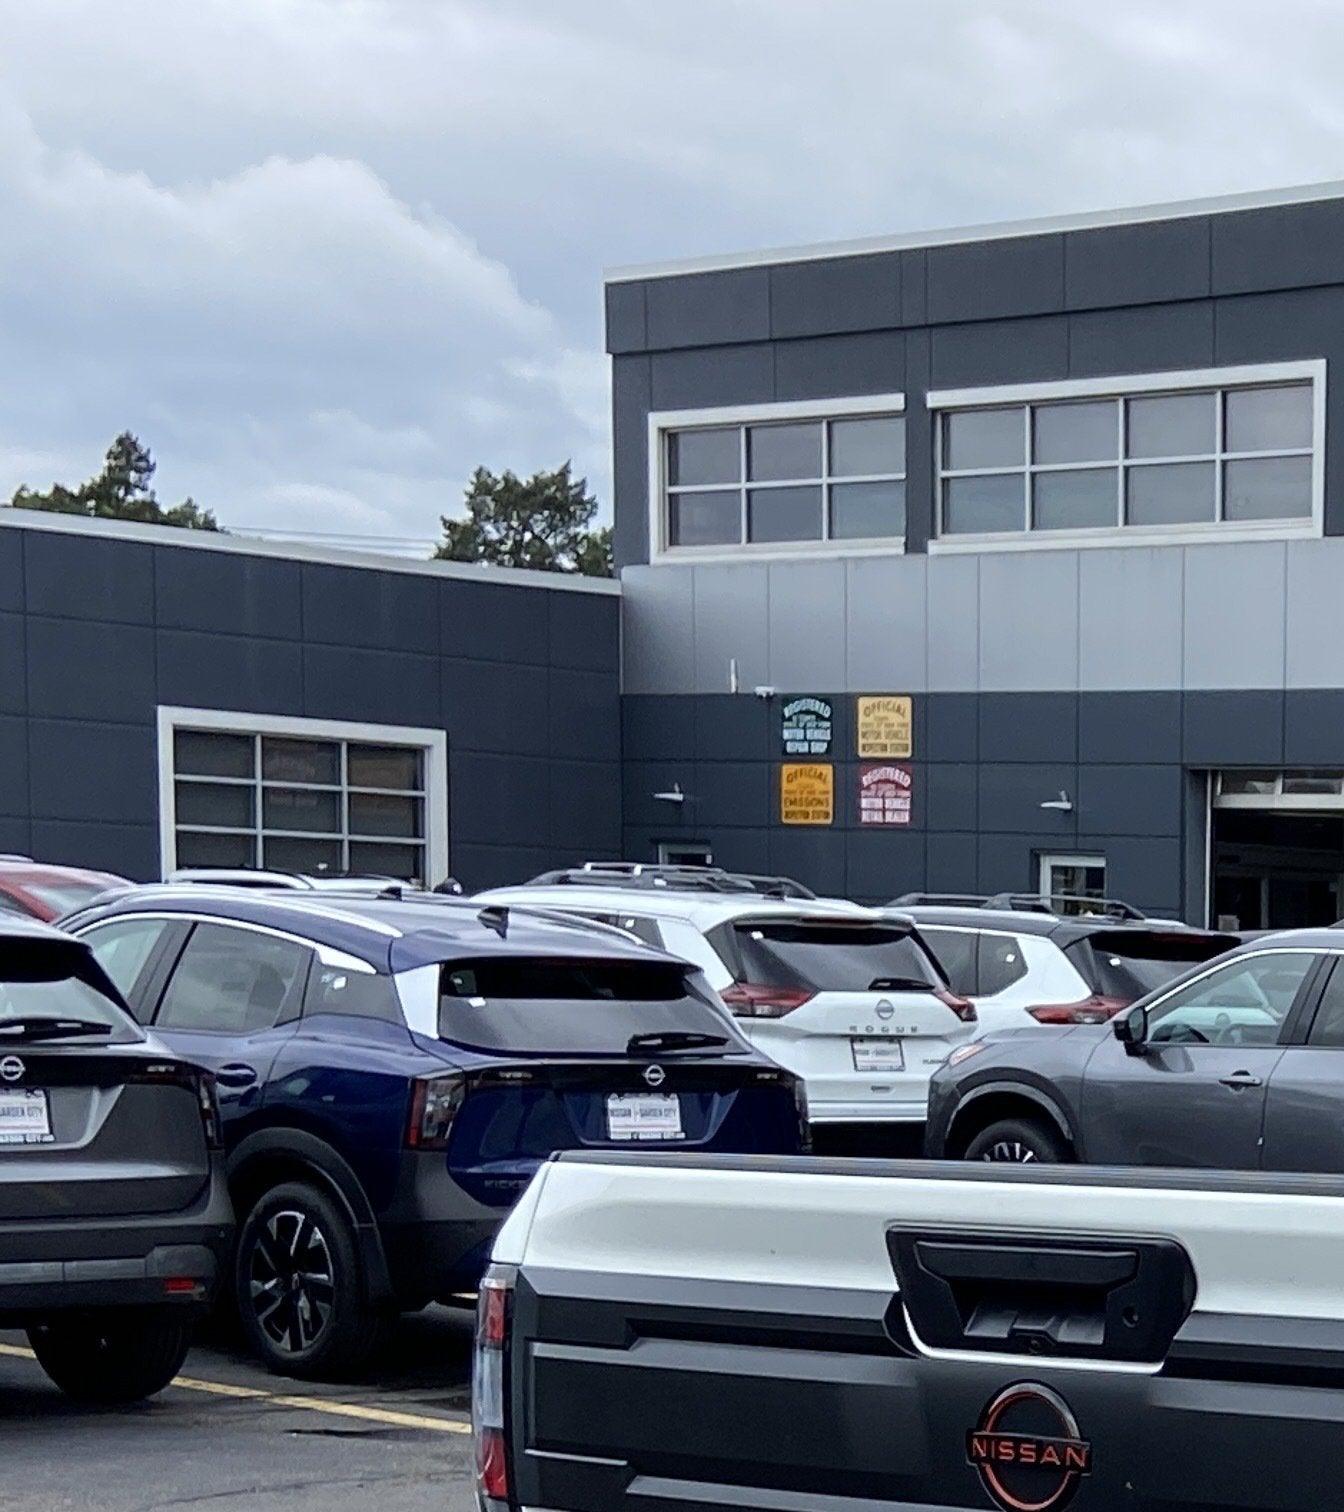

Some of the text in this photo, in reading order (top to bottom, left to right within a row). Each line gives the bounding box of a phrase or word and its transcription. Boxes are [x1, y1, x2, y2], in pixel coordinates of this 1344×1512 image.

[863, 700, 907, 718] OFFICIAL
[786, 767, 828, 784] OFFICIAL
[971, 1437, 1090, 1468] NISSAN
